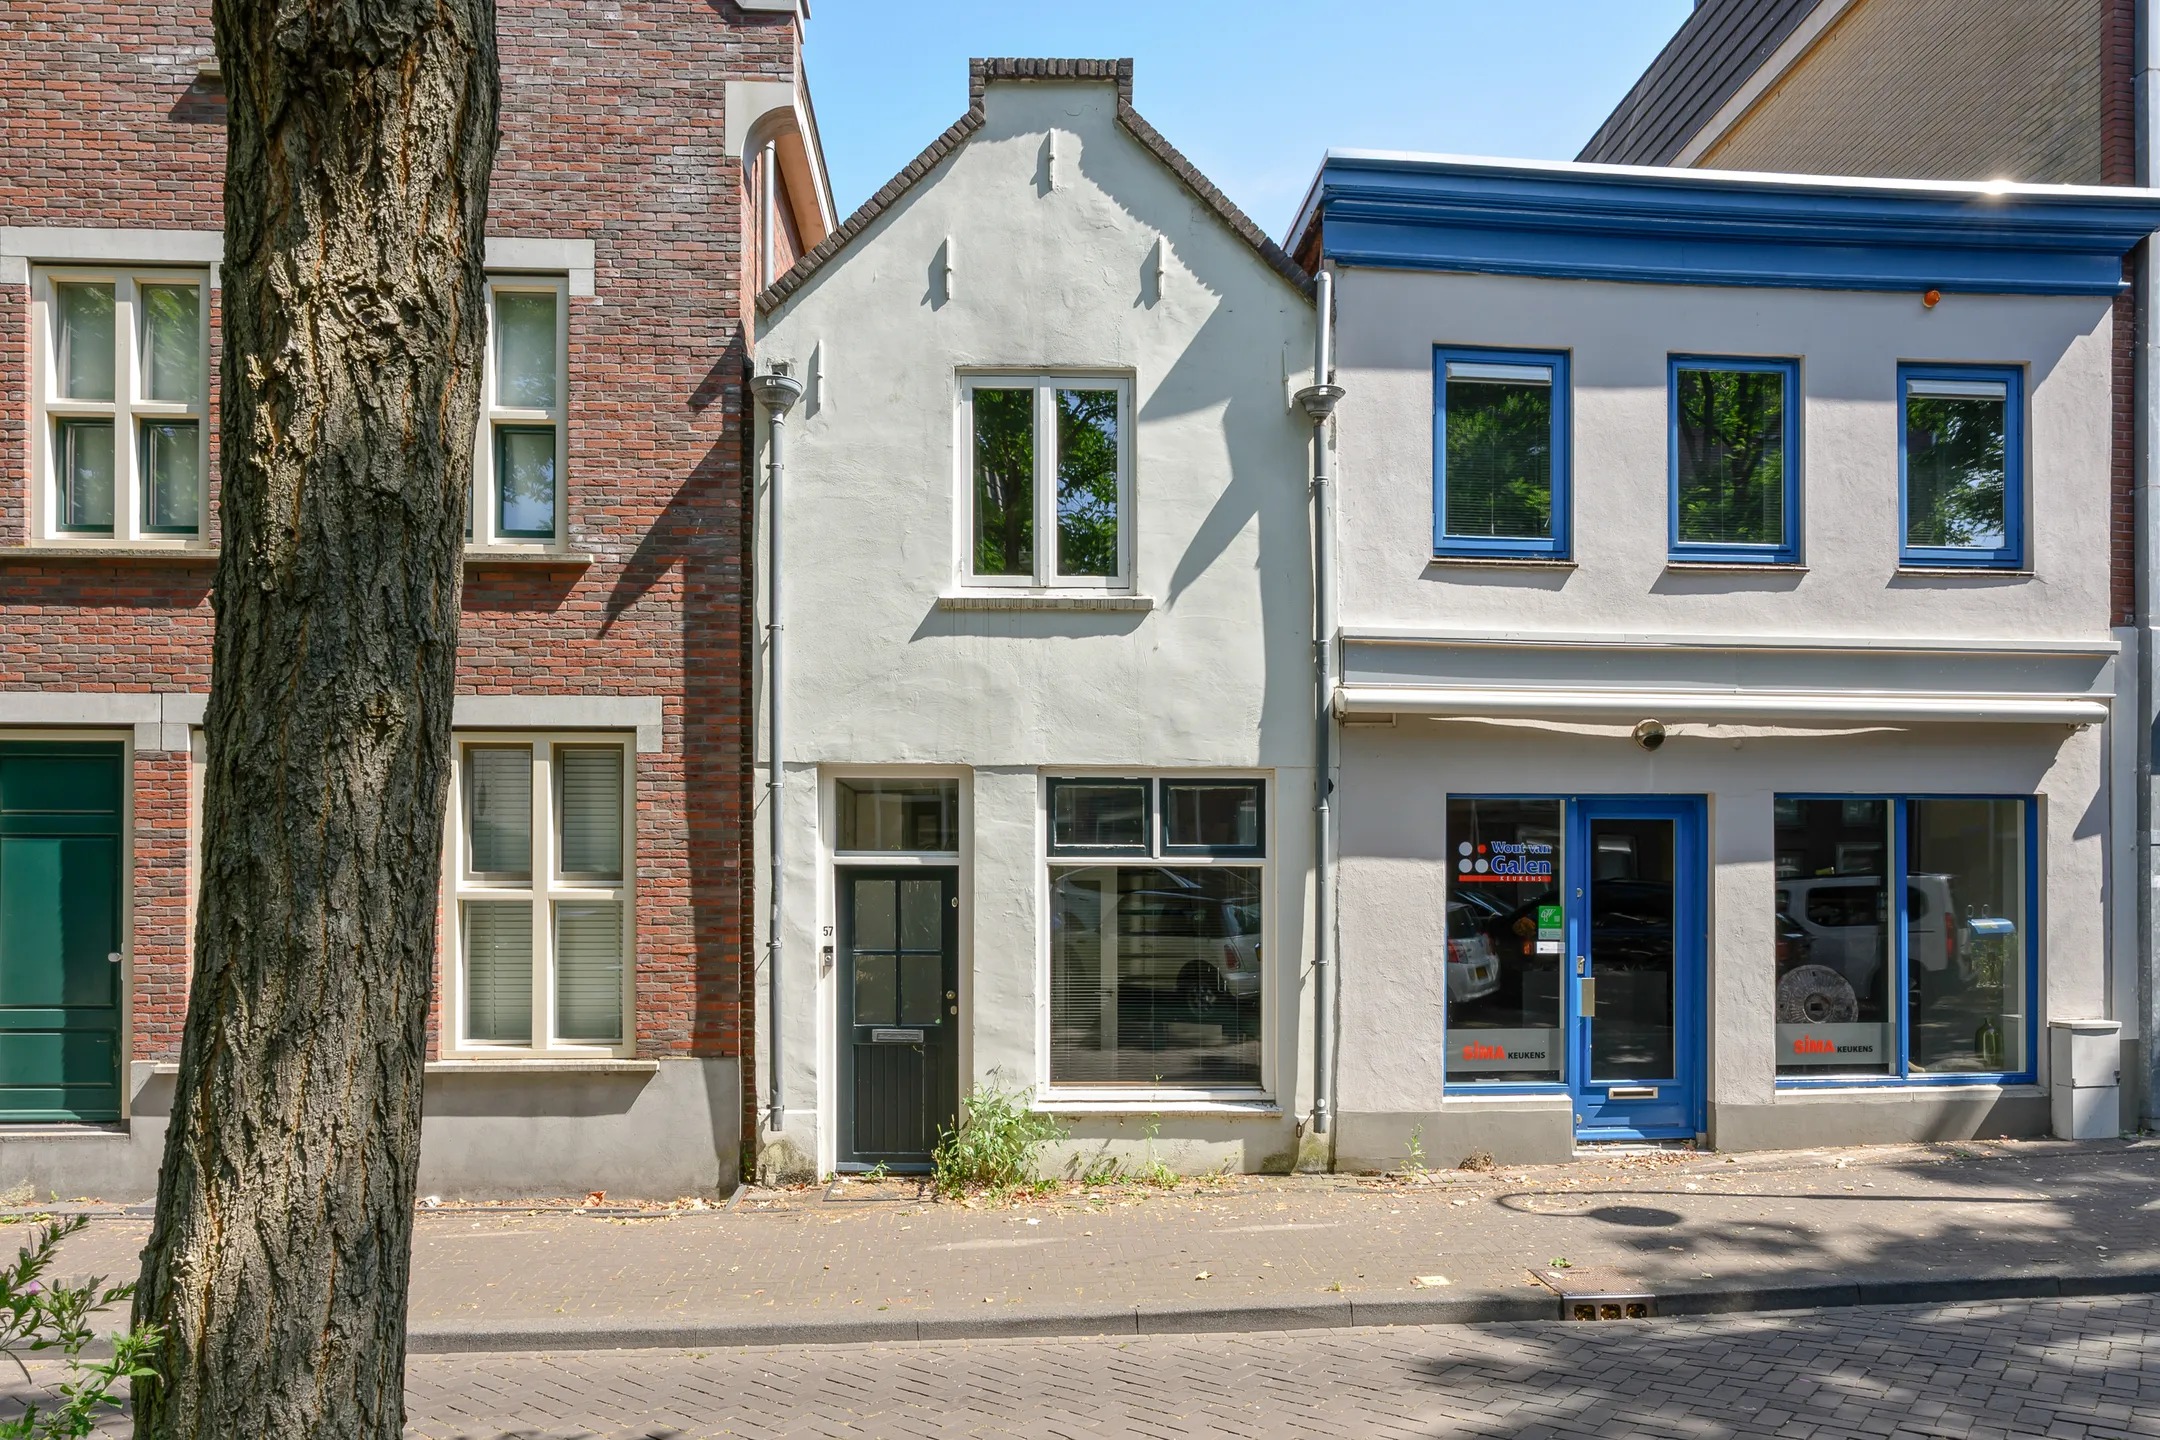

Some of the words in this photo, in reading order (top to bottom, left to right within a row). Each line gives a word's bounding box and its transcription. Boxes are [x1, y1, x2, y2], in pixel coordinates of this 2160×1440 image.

[1491, 841, 1526, 854] Wout
[1527, 844, 1553, 854] van
[1491, 855, 1552, 875] Galen
[823, 926, 834, 936] 57
[1836, 1045, 1873, 1053] KEUKENS
[1507, 1051, 1546, 1060] KEUKENS
